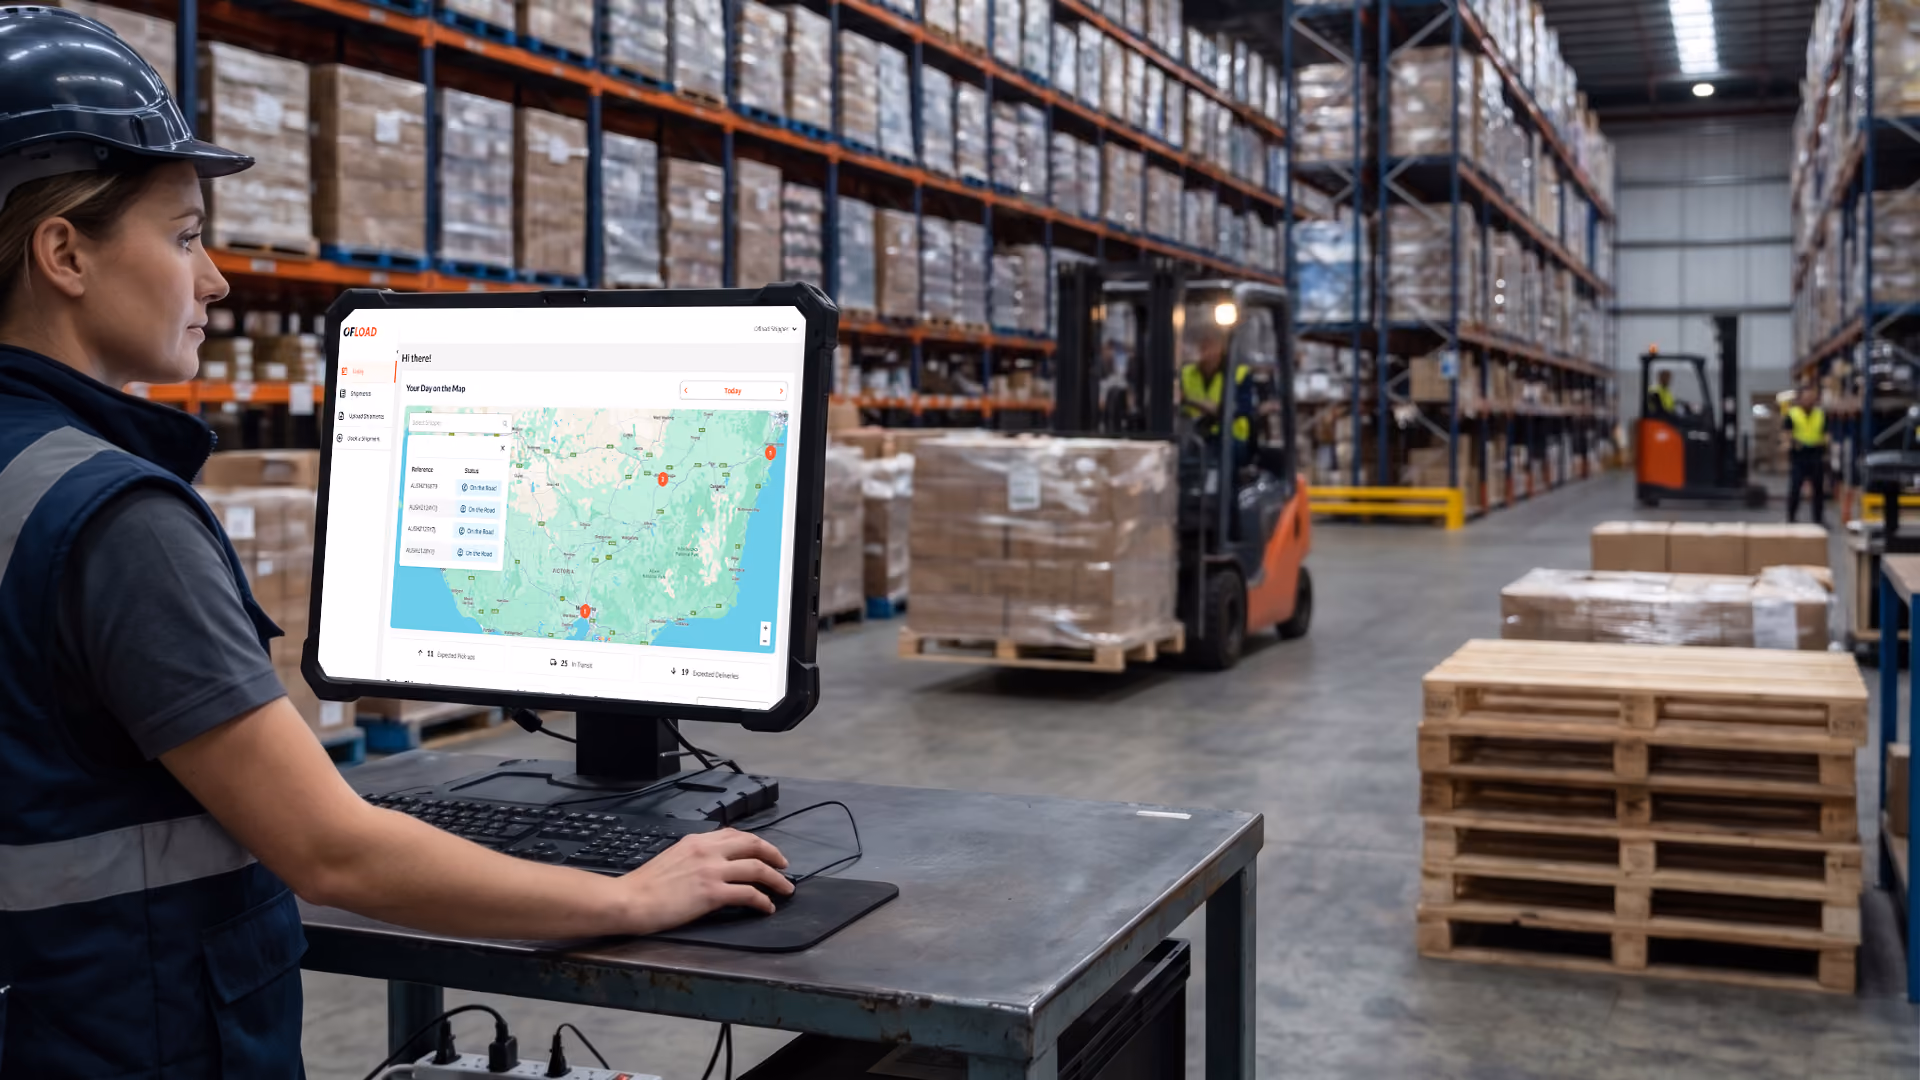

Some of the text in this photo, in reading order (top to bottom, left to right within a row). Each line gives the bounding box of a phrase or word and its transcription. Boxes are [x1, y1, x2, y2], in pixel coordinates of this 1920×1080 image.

[343, 326, 377, 337] OFLOAD
[401, 353, 432, 363] Hi there!
[406, 383, 420, 392] Your
[420, 384, 432, 393] Day
[441, 385, 452, 393] the
[451, 384, 466, 394] Map
[723, 387, 742, 396] Today
[560, 659, 568, 667] 25
